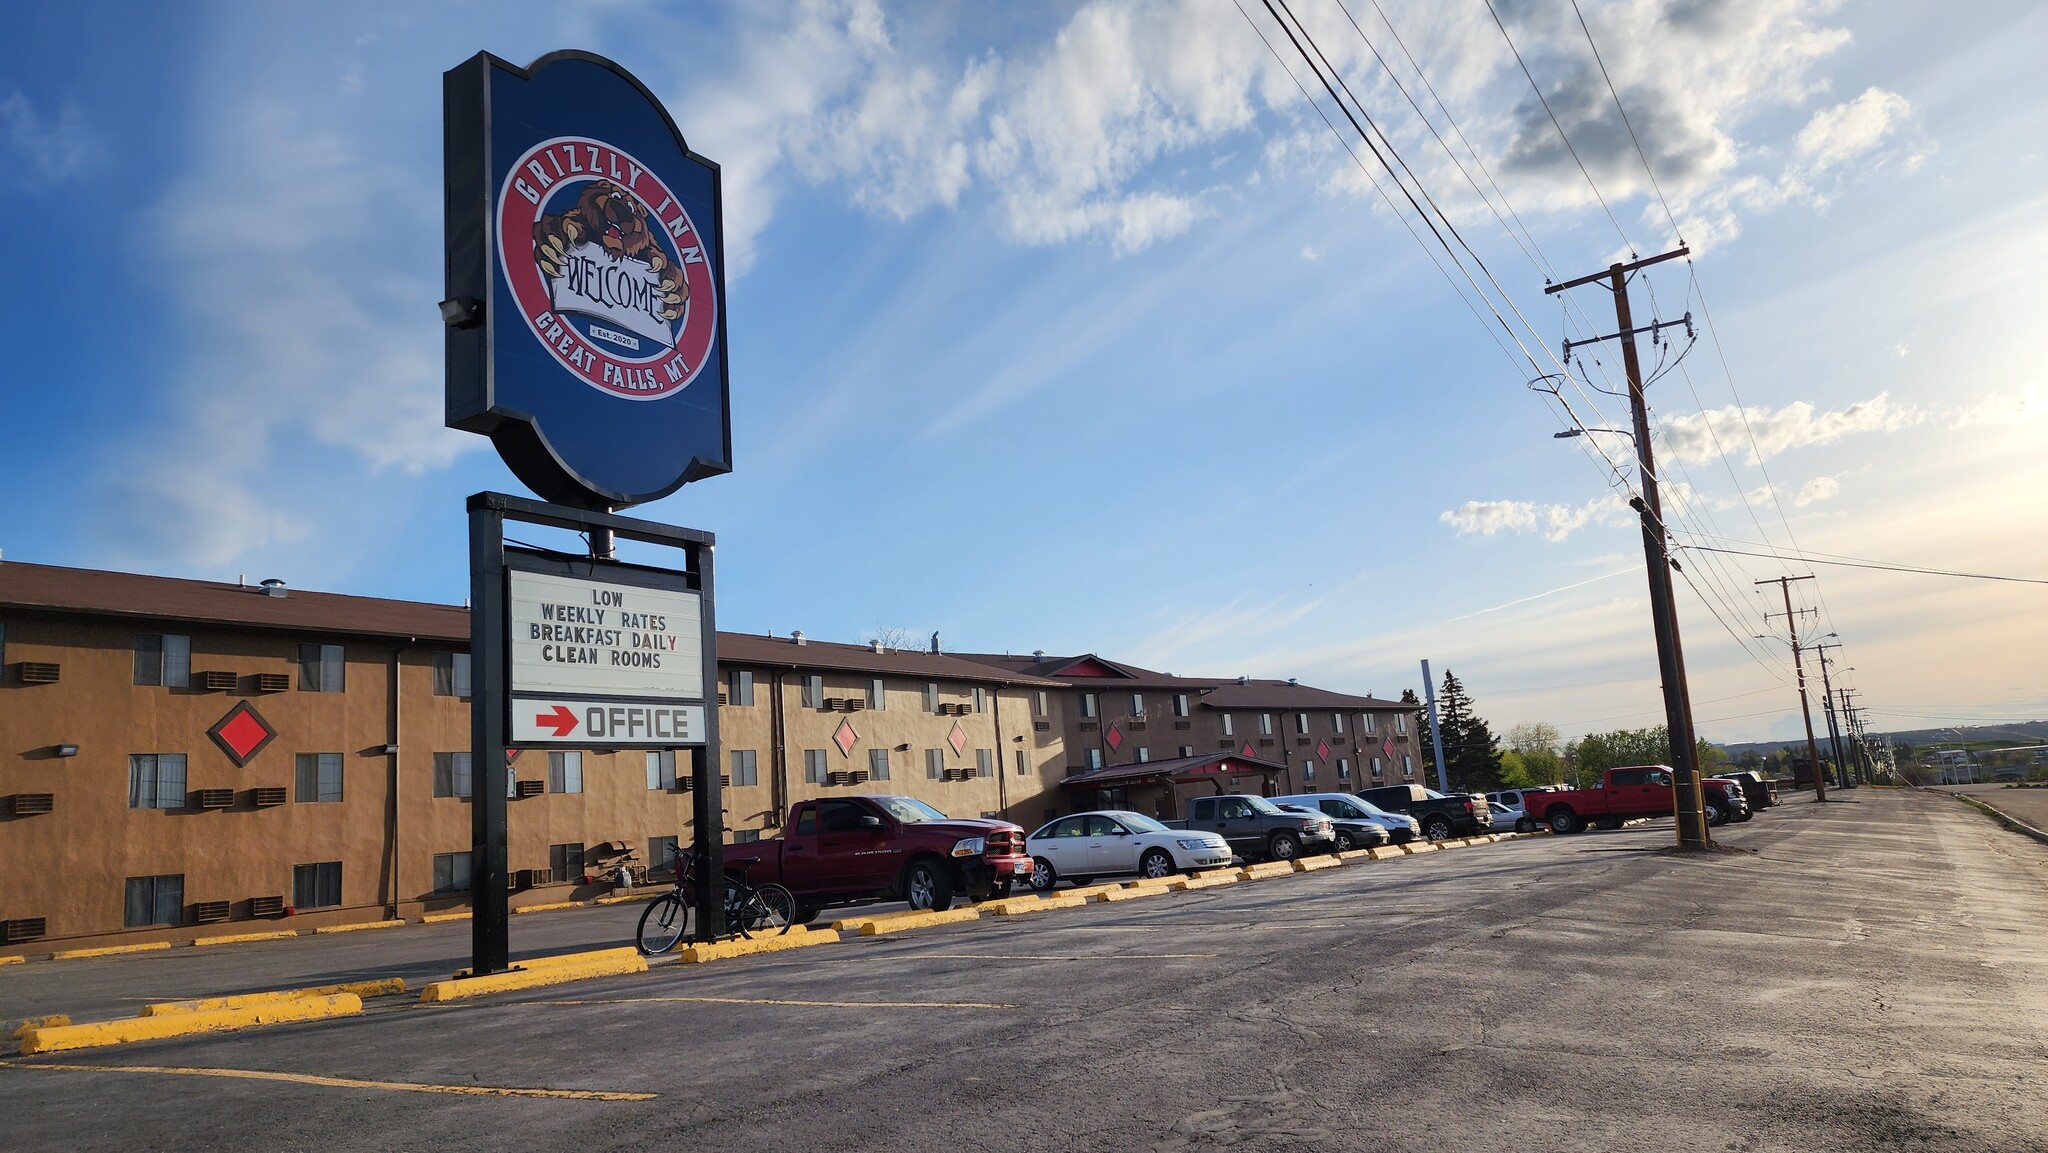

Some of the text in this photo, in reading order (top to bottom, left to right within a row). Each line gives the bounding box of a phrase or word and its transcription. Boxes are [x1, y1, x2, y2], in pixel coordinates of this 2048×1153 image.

[514, 144, 704, 265] GRIZZLY INN
[567, 256, 664, 324] WELCOME
[534, 310, 690, 391] GREAT FALLS, MT
[597, 329, 632, 346] Est. 2020
[592, 588, 623, 608] LOW
[541, 603, 666, 631] WEEKLY RATES
[530, 622, 677, 651] BREAKFAST DAILY
[542, 645, 661, 669] CLEAN ROOMS
[586, 707, 689, 738] OFFICE
